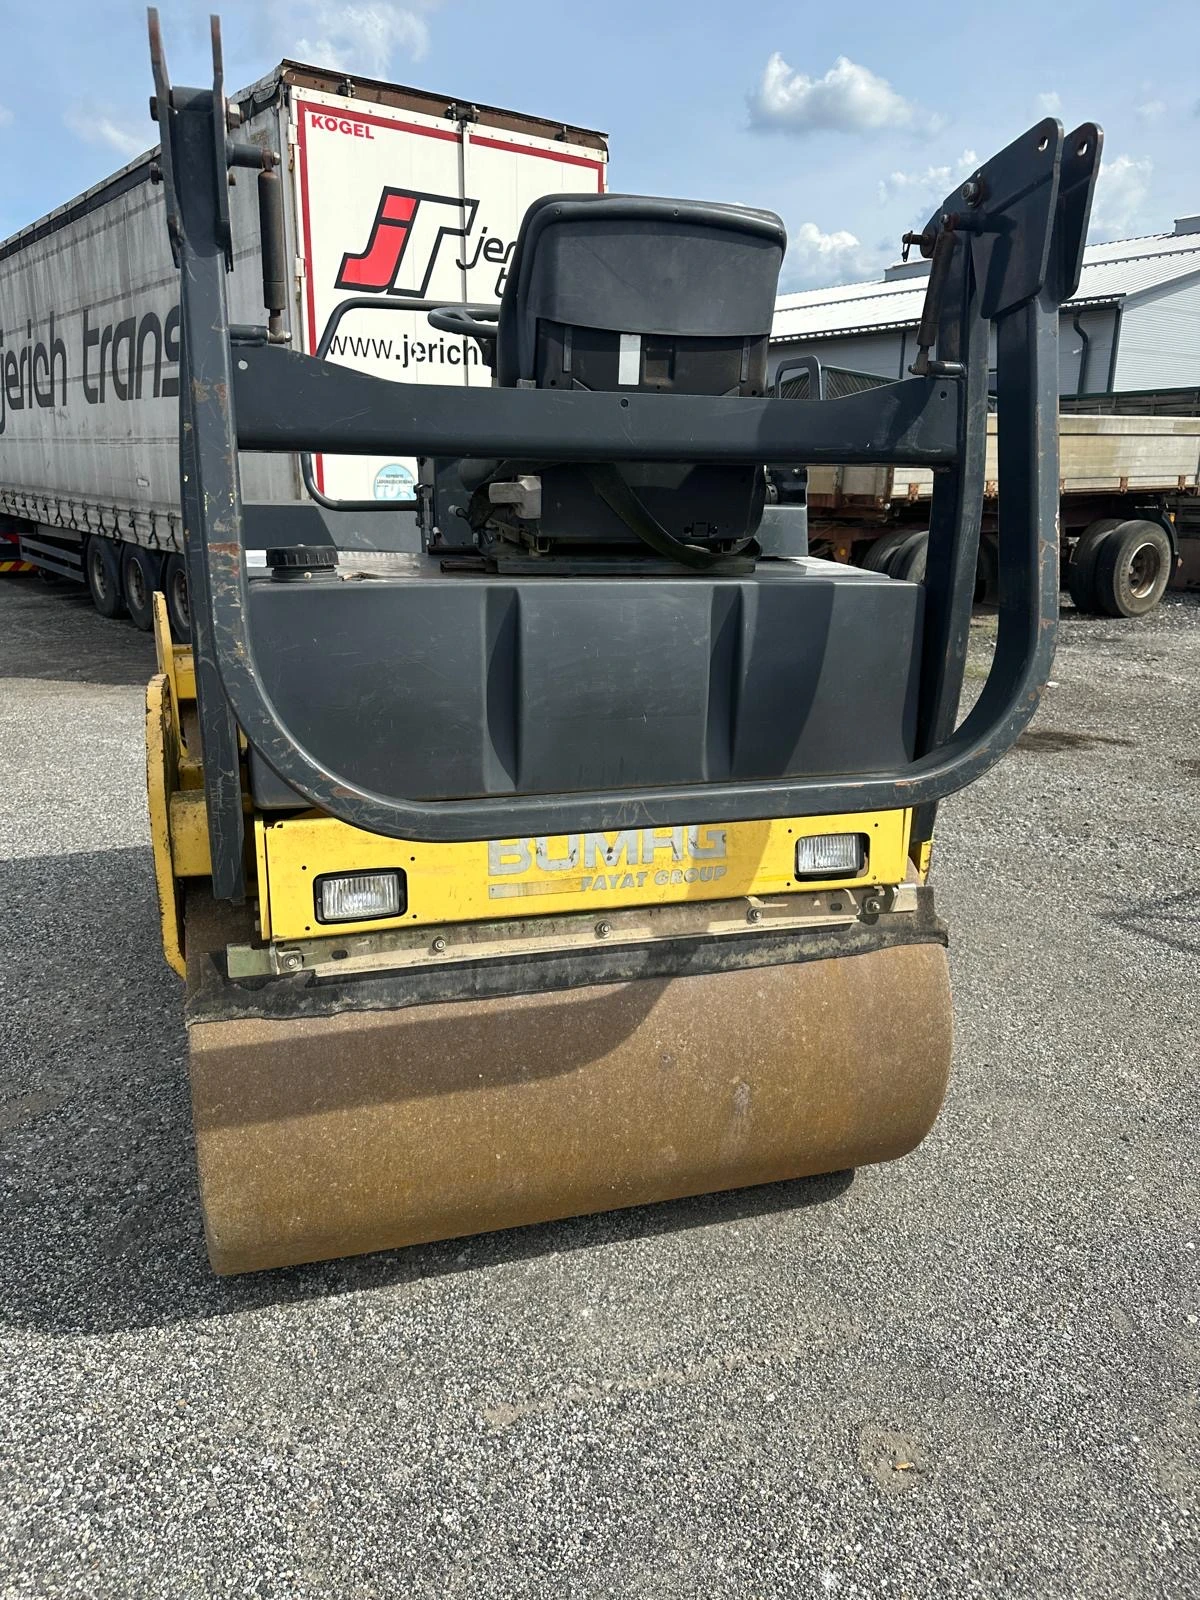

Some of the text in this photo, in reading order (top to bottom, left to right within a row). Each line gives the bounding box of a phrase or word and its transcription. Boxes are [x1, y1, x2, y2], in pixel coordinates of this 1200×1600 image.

[311, 114, 375, 140] KÖGEL
[580, 866, 727, 892] FAYAT GROUP
